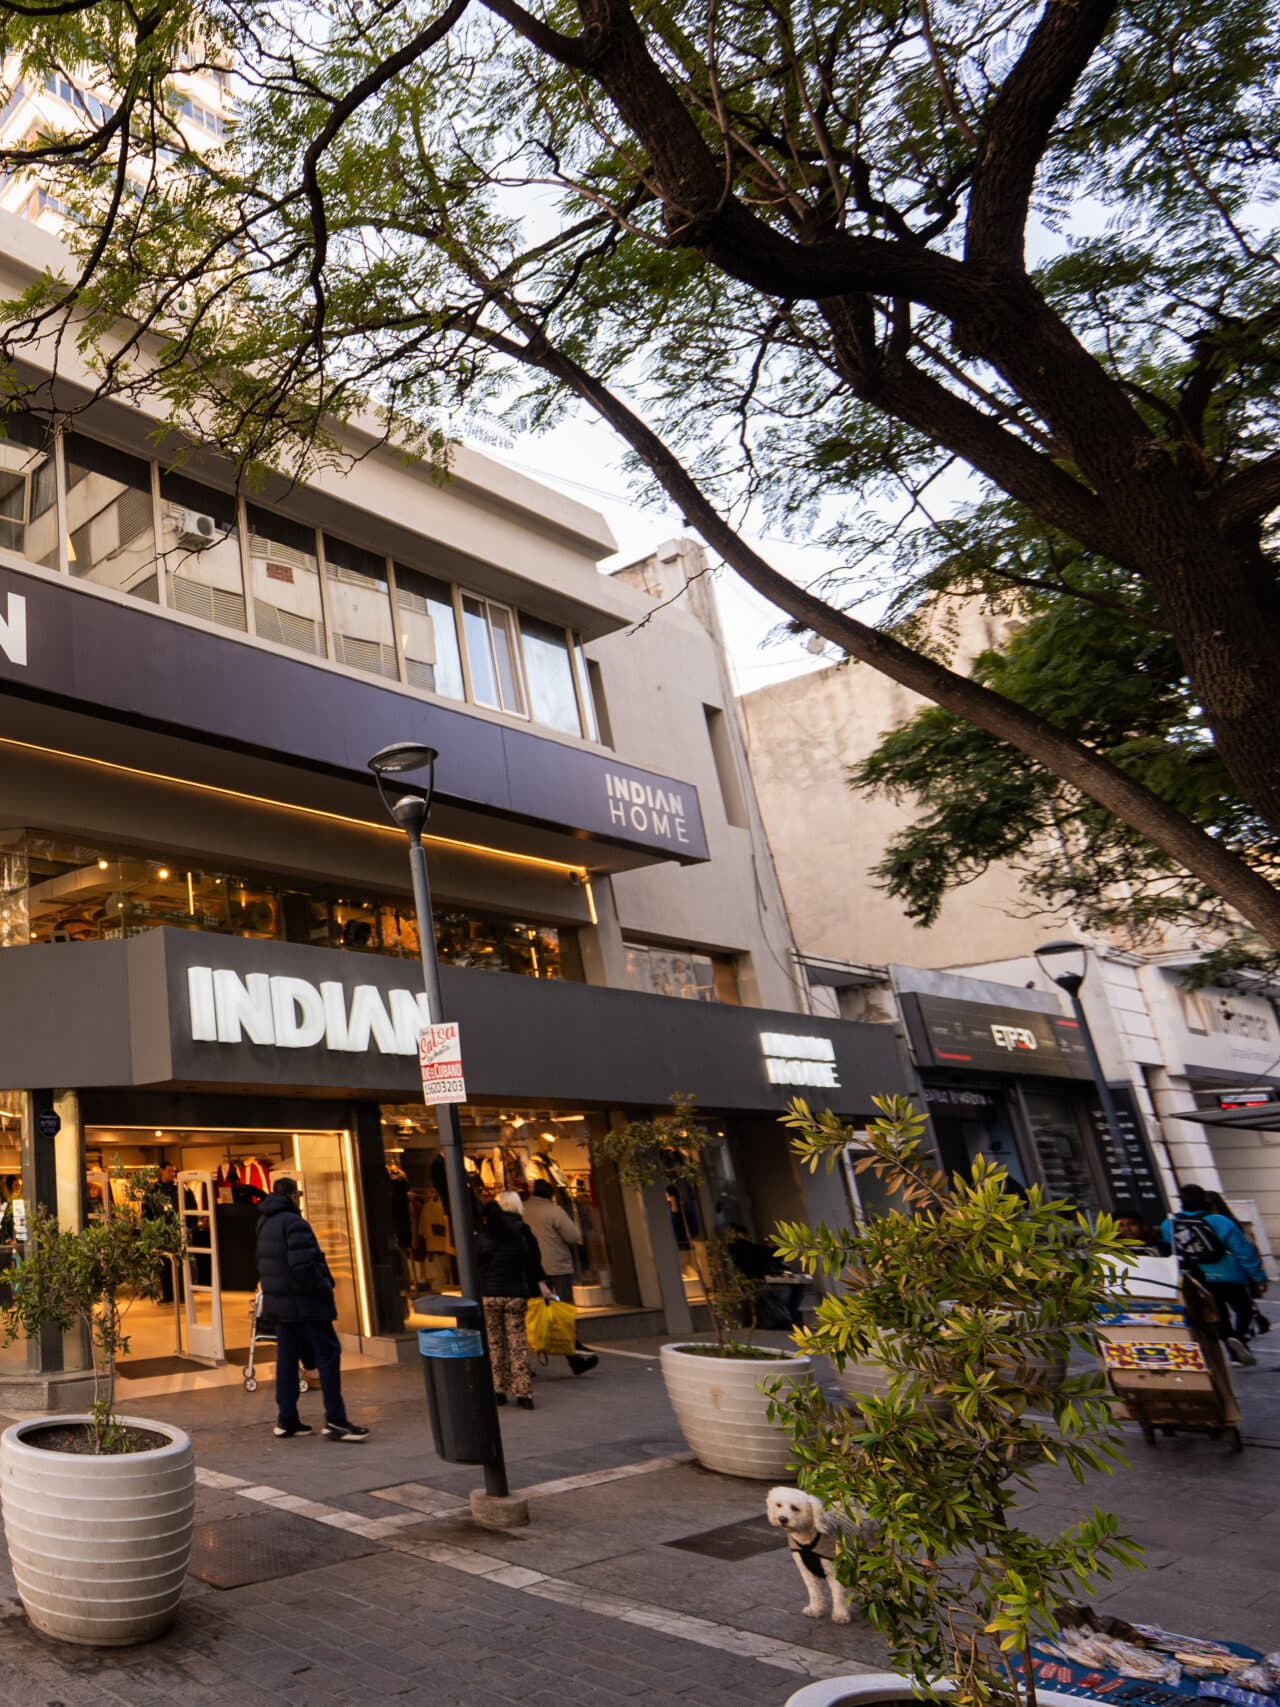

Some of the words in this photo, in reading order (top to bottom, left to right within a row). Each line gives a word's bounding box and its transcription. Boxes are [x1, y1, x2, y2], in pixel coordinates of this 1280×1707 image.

[605, 773, 684, 817] INDIAN
[609, 798, 689, 843] HOME
[187, 965, 431, 1056] INDIAN
